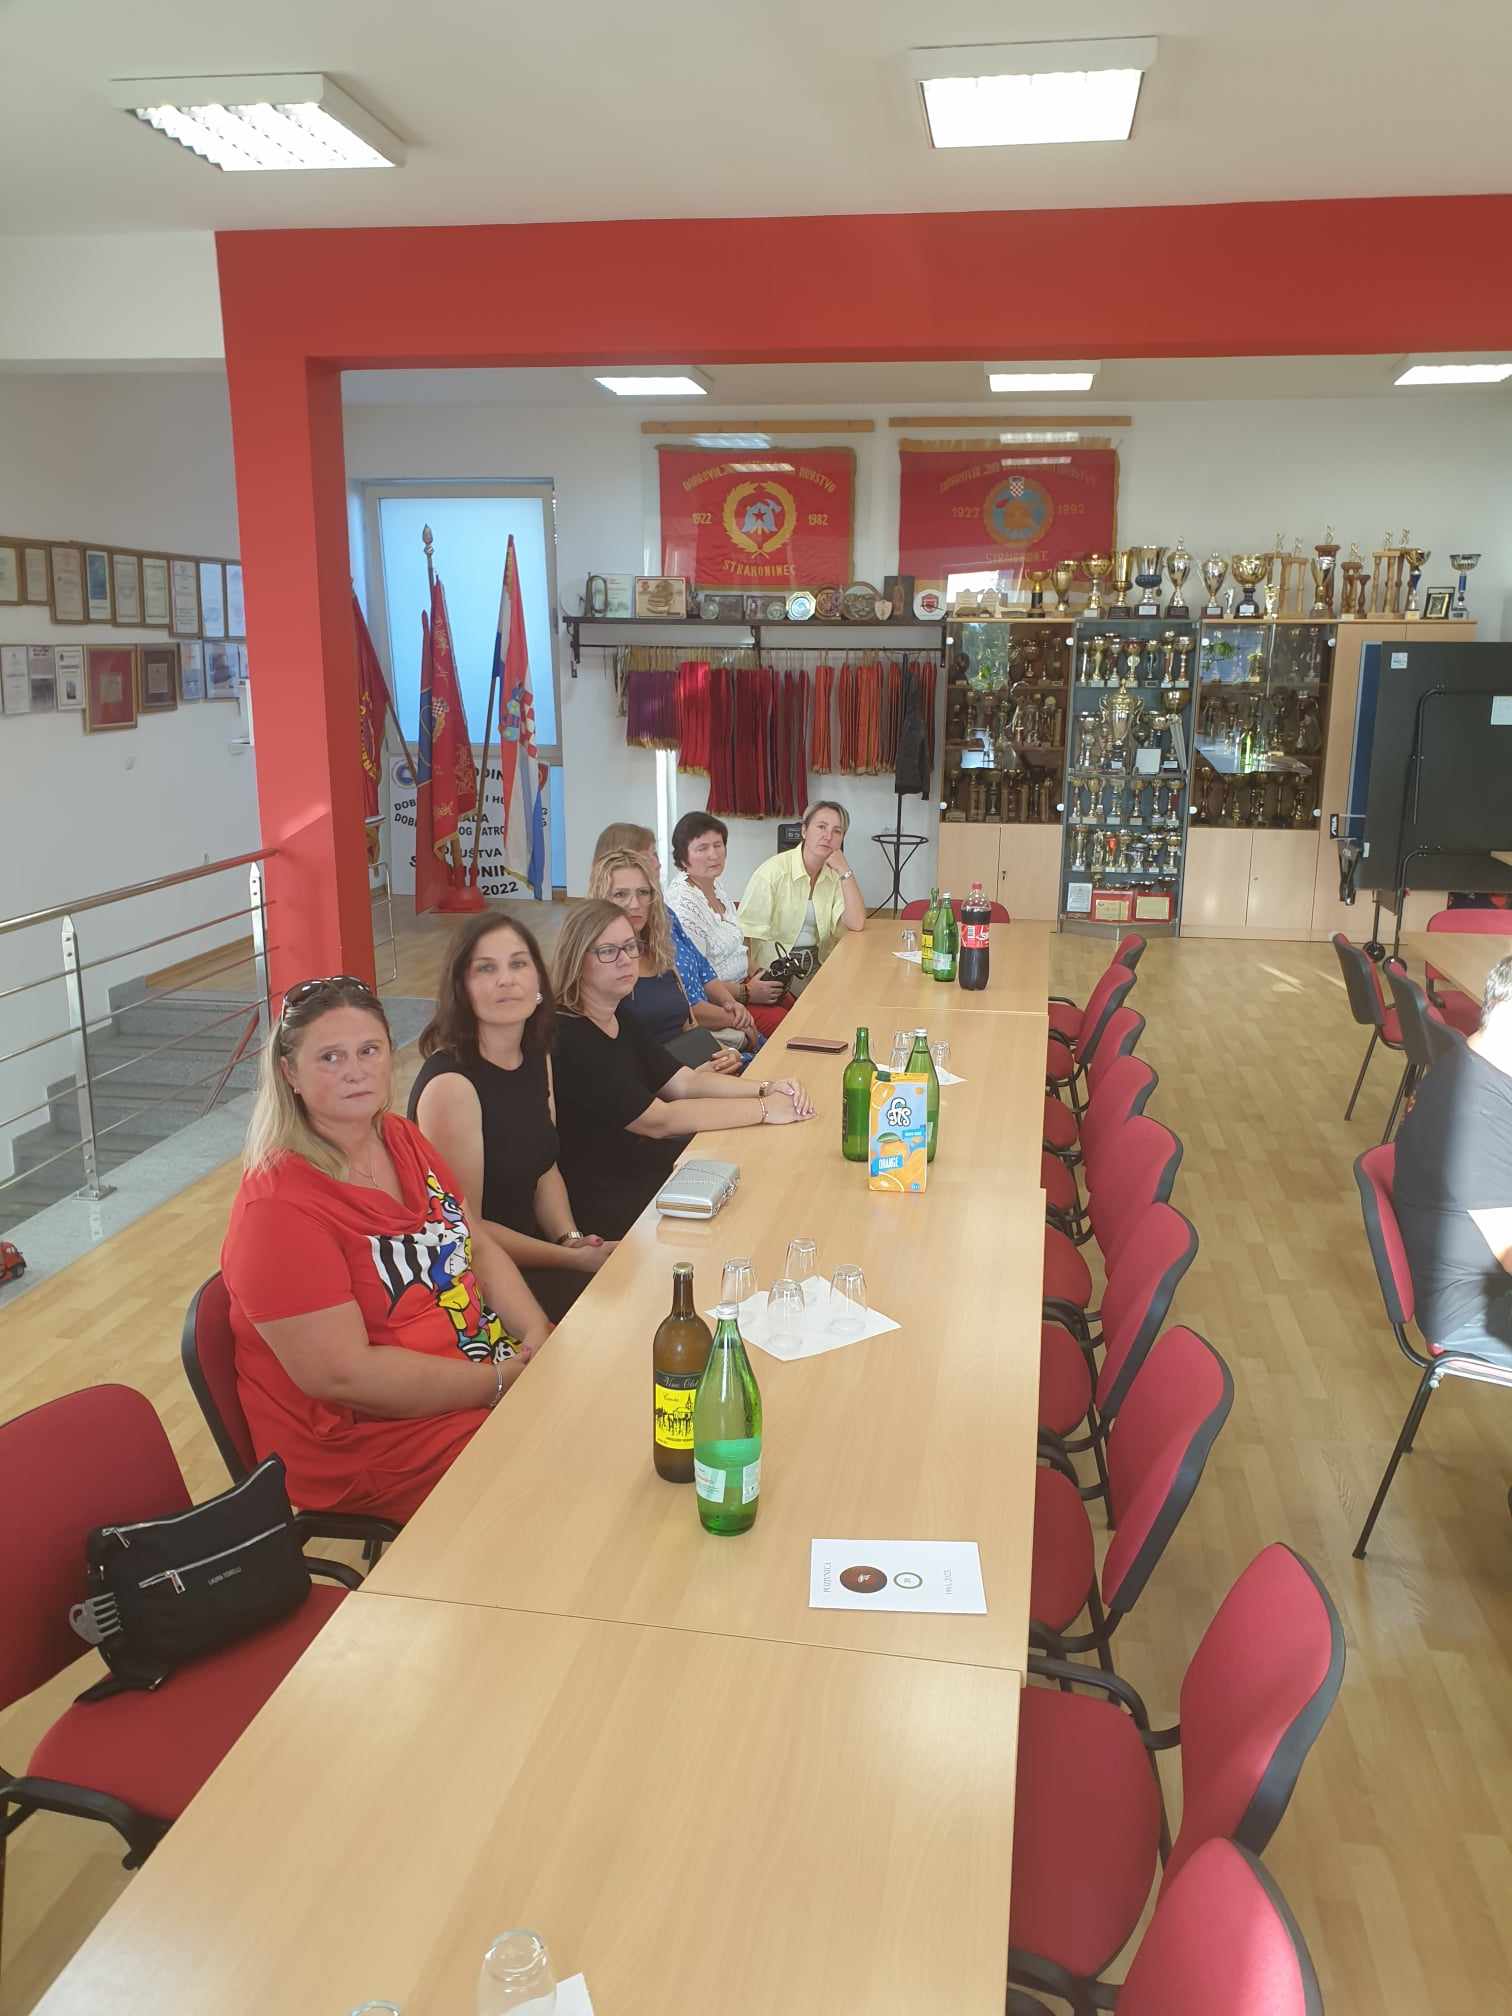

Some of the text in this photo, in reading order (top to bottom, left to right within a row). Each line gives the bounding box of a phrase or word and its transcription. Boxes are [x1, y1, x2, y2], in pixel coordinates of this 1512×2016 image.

[692, 512, 712, 525] 1922
[808, 514, 828, 526] 1982
[481, 881, 519, 896] 2022
